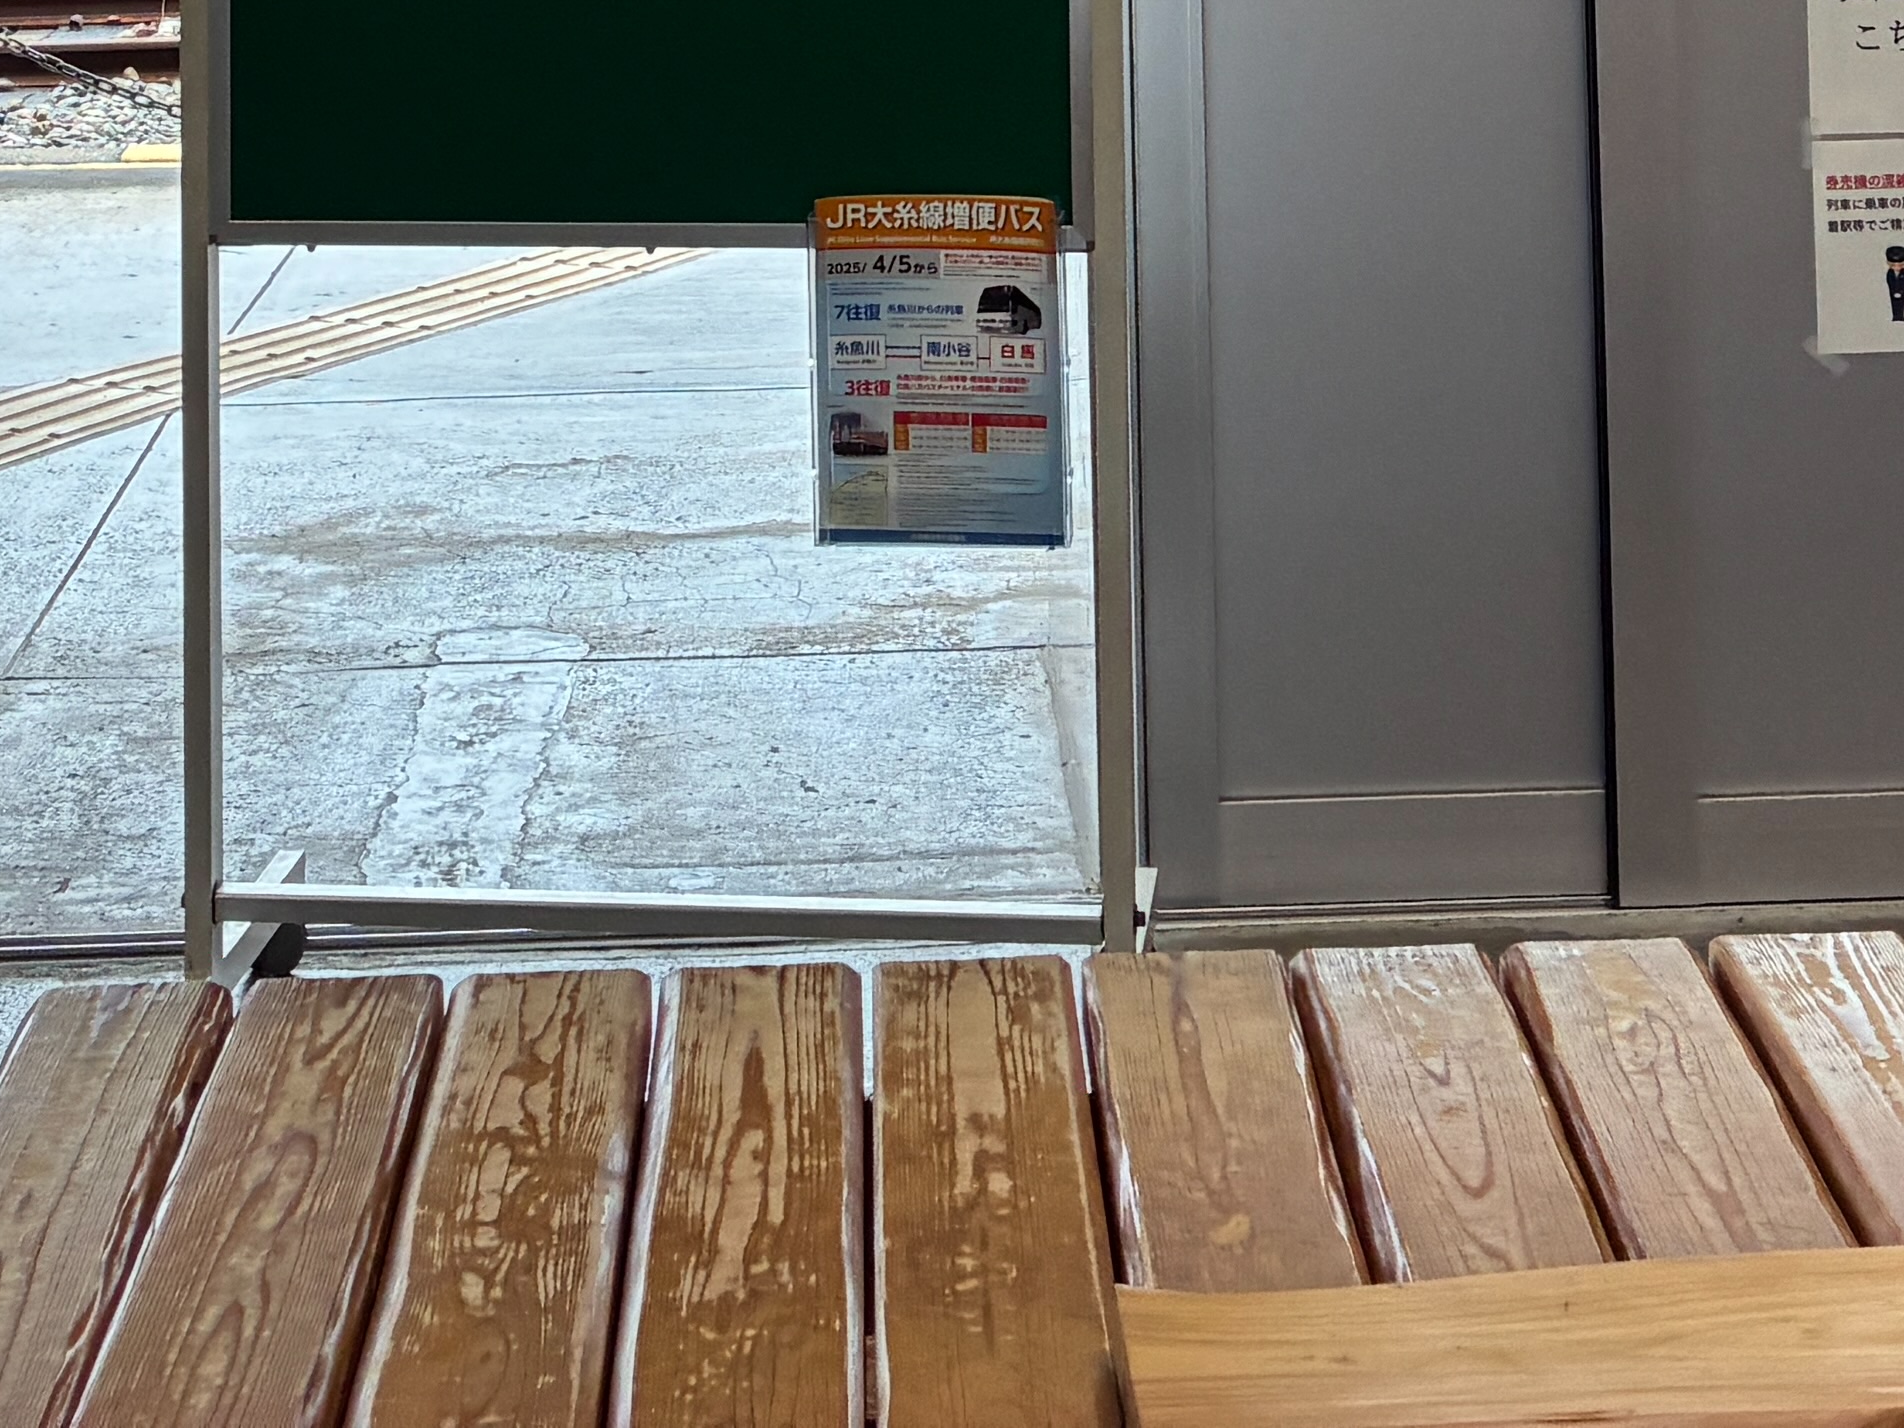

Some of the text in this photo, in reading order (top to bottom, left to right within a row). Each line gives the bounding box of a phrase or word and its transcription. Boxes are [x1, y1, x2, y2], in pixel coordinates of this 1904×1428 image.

[827, 202, 1043, 232] JR大糸線増便バス
[834, 303, 881, 321] 7往復
[835, 341, 880, 356] 糸魚川
[927, 342, 971, 357] 南小谷
